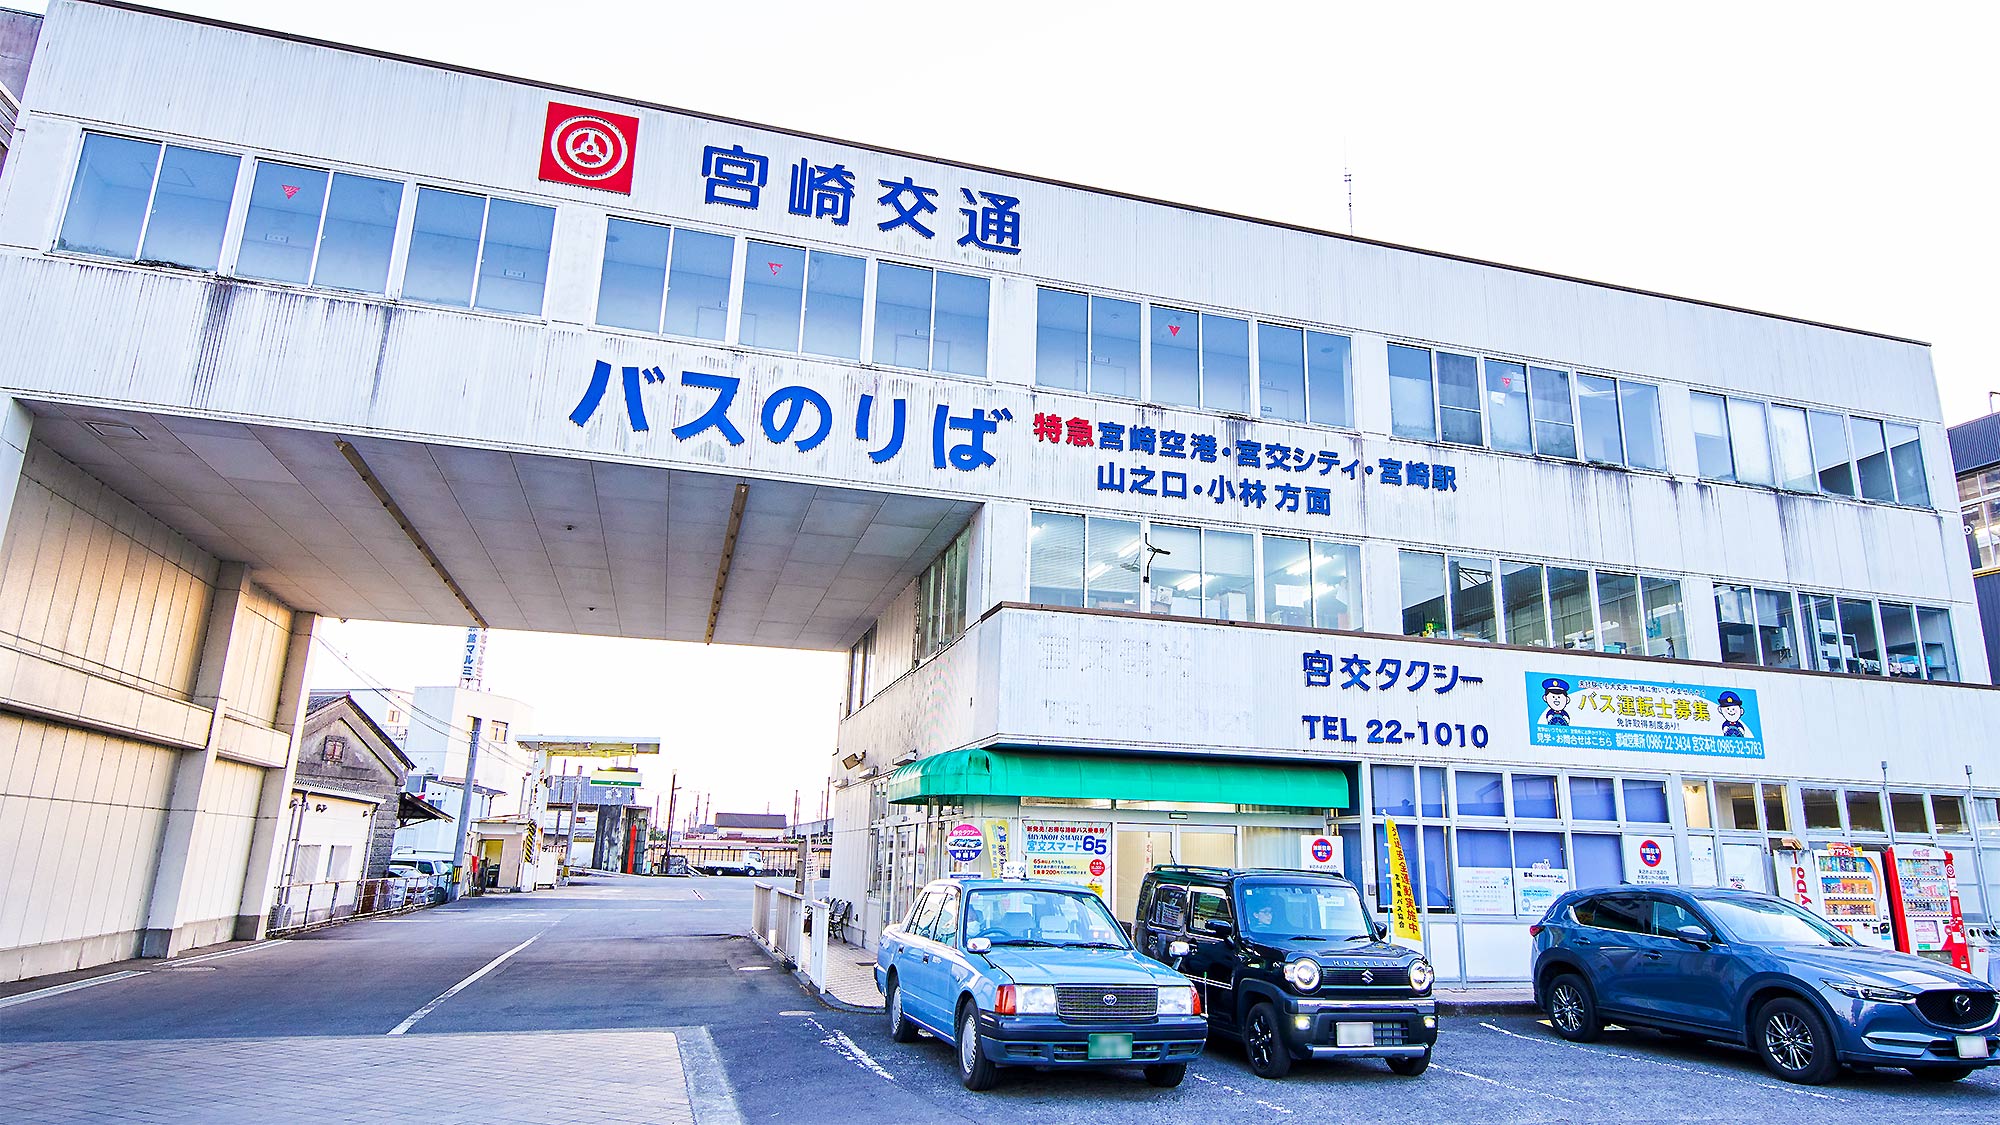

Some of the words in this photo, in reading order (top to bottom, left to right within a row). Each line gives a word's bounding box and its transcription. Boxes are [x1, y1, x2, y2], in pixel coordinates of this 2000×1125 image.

[701, 144, 1021, 255] 宮崎交通
[569, 360, 1014, 472] バスのりば
[1303, 650, 1483, 694] 宮交タクシー
[1578, 691, 1711, 722] バス運転士募集
[1302, 714, 1357, 743] TEL
[1366, 719, 1489, 749] 22-1010
[1537, 732, 1613, 747] 見学・お問合せはこちら
[1645, 734, 1692, 752] 0986-22-3434
[1717, 738, 1763, 756] 0985-32-5783
[1332, 960, 1399, 968] HUSTLER
